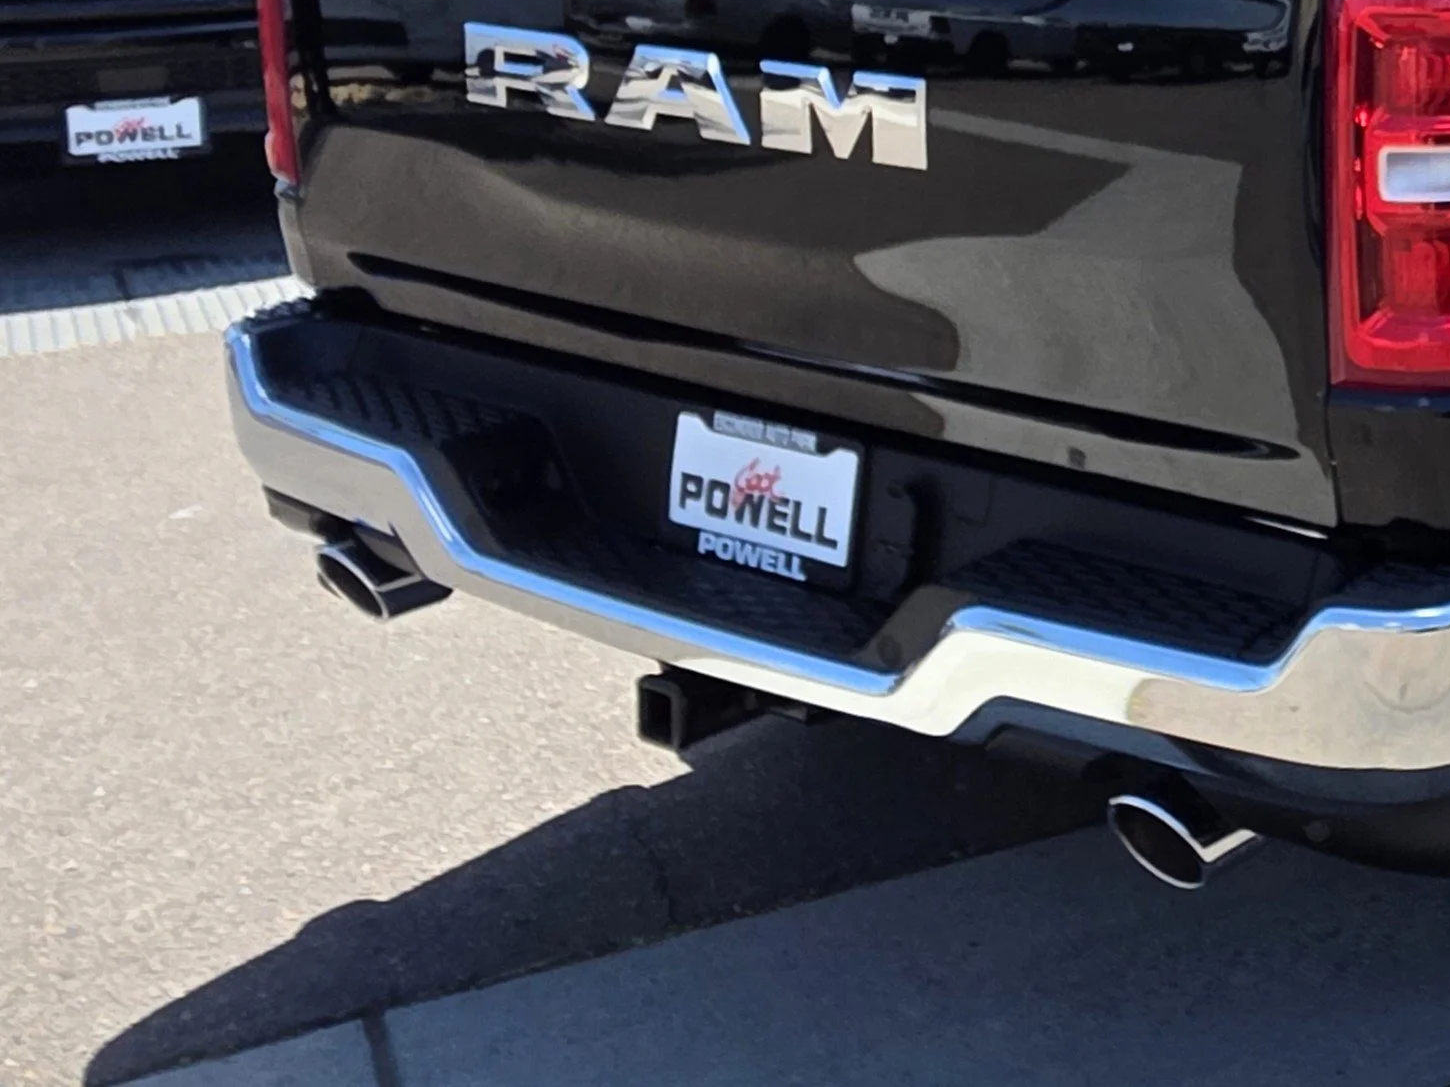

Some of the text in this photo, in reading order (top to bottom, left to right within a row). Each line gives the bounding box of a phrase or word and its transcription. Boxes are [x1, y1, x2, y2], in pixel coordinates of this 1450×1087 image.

[464, 21, 928, 171] RAM
[75, 122, 192, 148] POWELL
[679, 471, 839, 550] POWELL
[697, 531, 807, 582] POWELL
